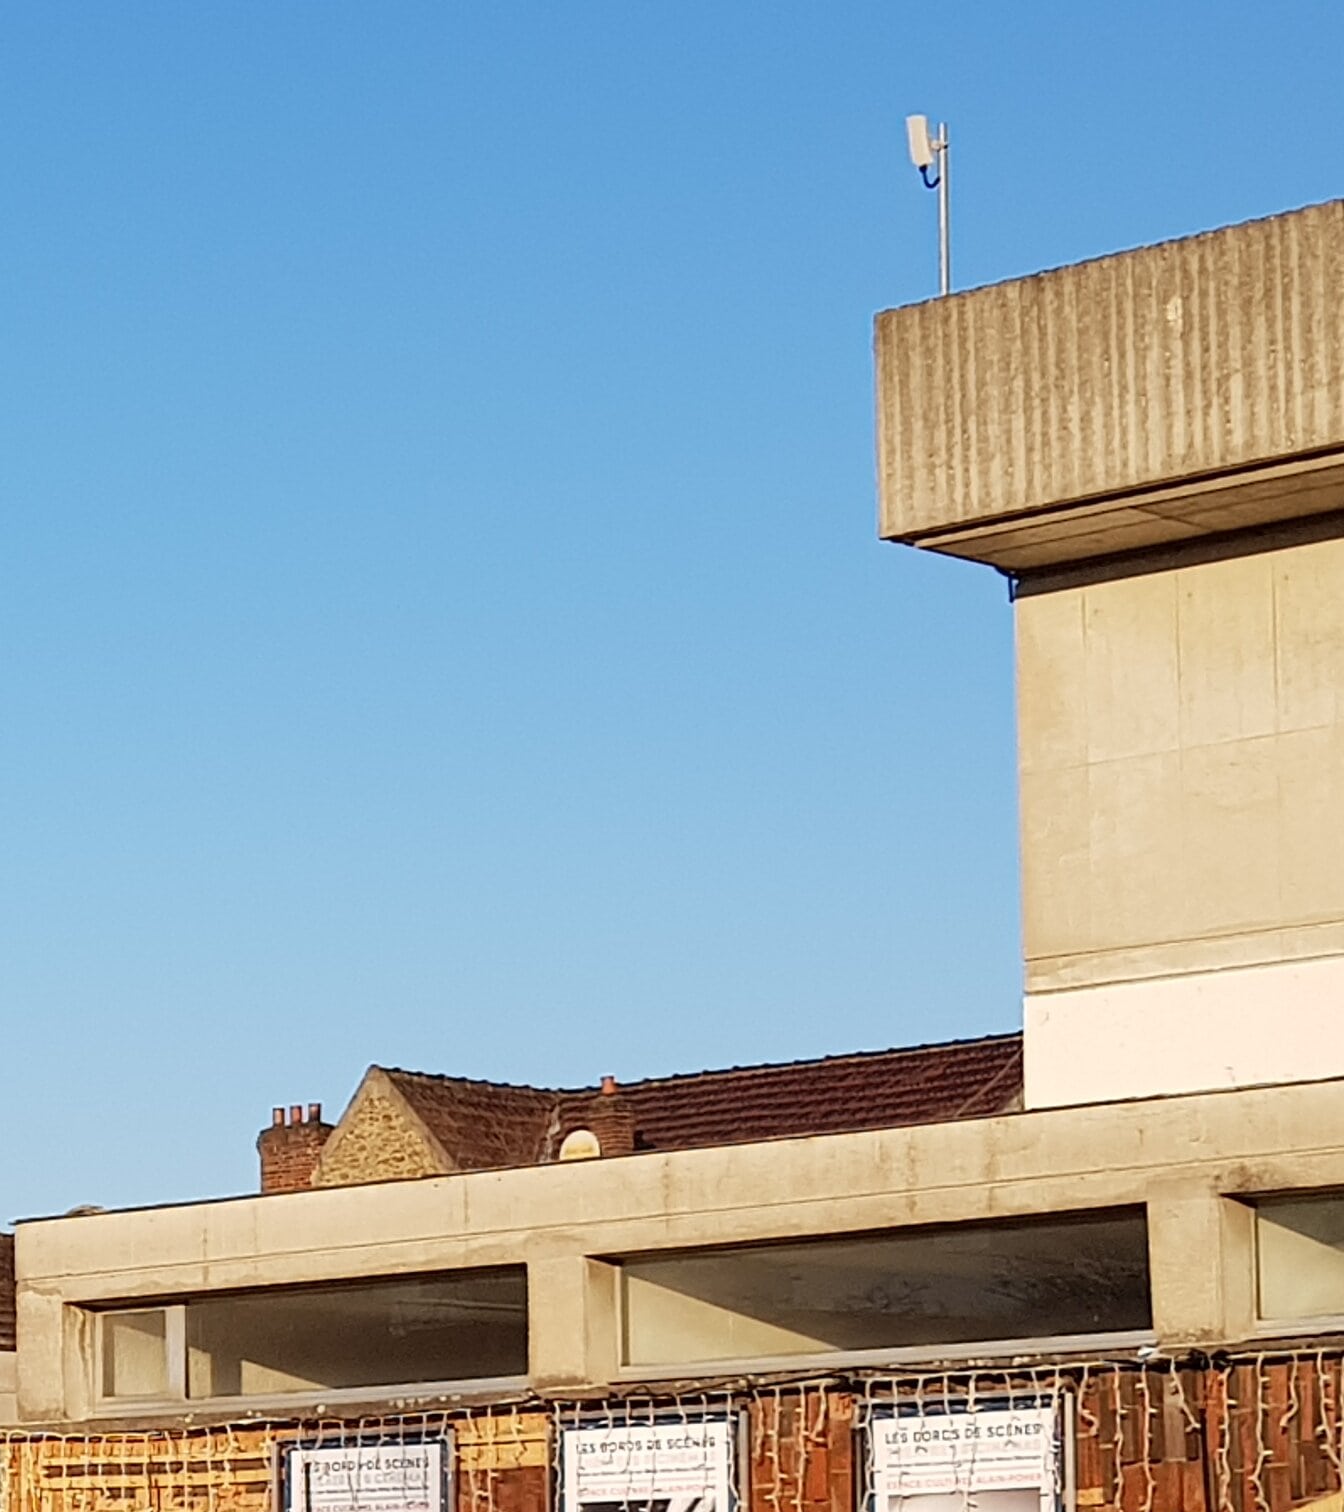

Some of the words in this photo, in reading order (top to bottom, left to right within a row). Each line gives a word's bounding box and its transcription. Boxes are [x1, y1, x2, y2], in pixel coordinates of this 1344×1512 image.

[885, 1432, 908, 1444] LES
[965, 1427, 981, 1439] DE
[577, 1443, 596, 1454] LES
[647, 1438, 661, 1450] DE
